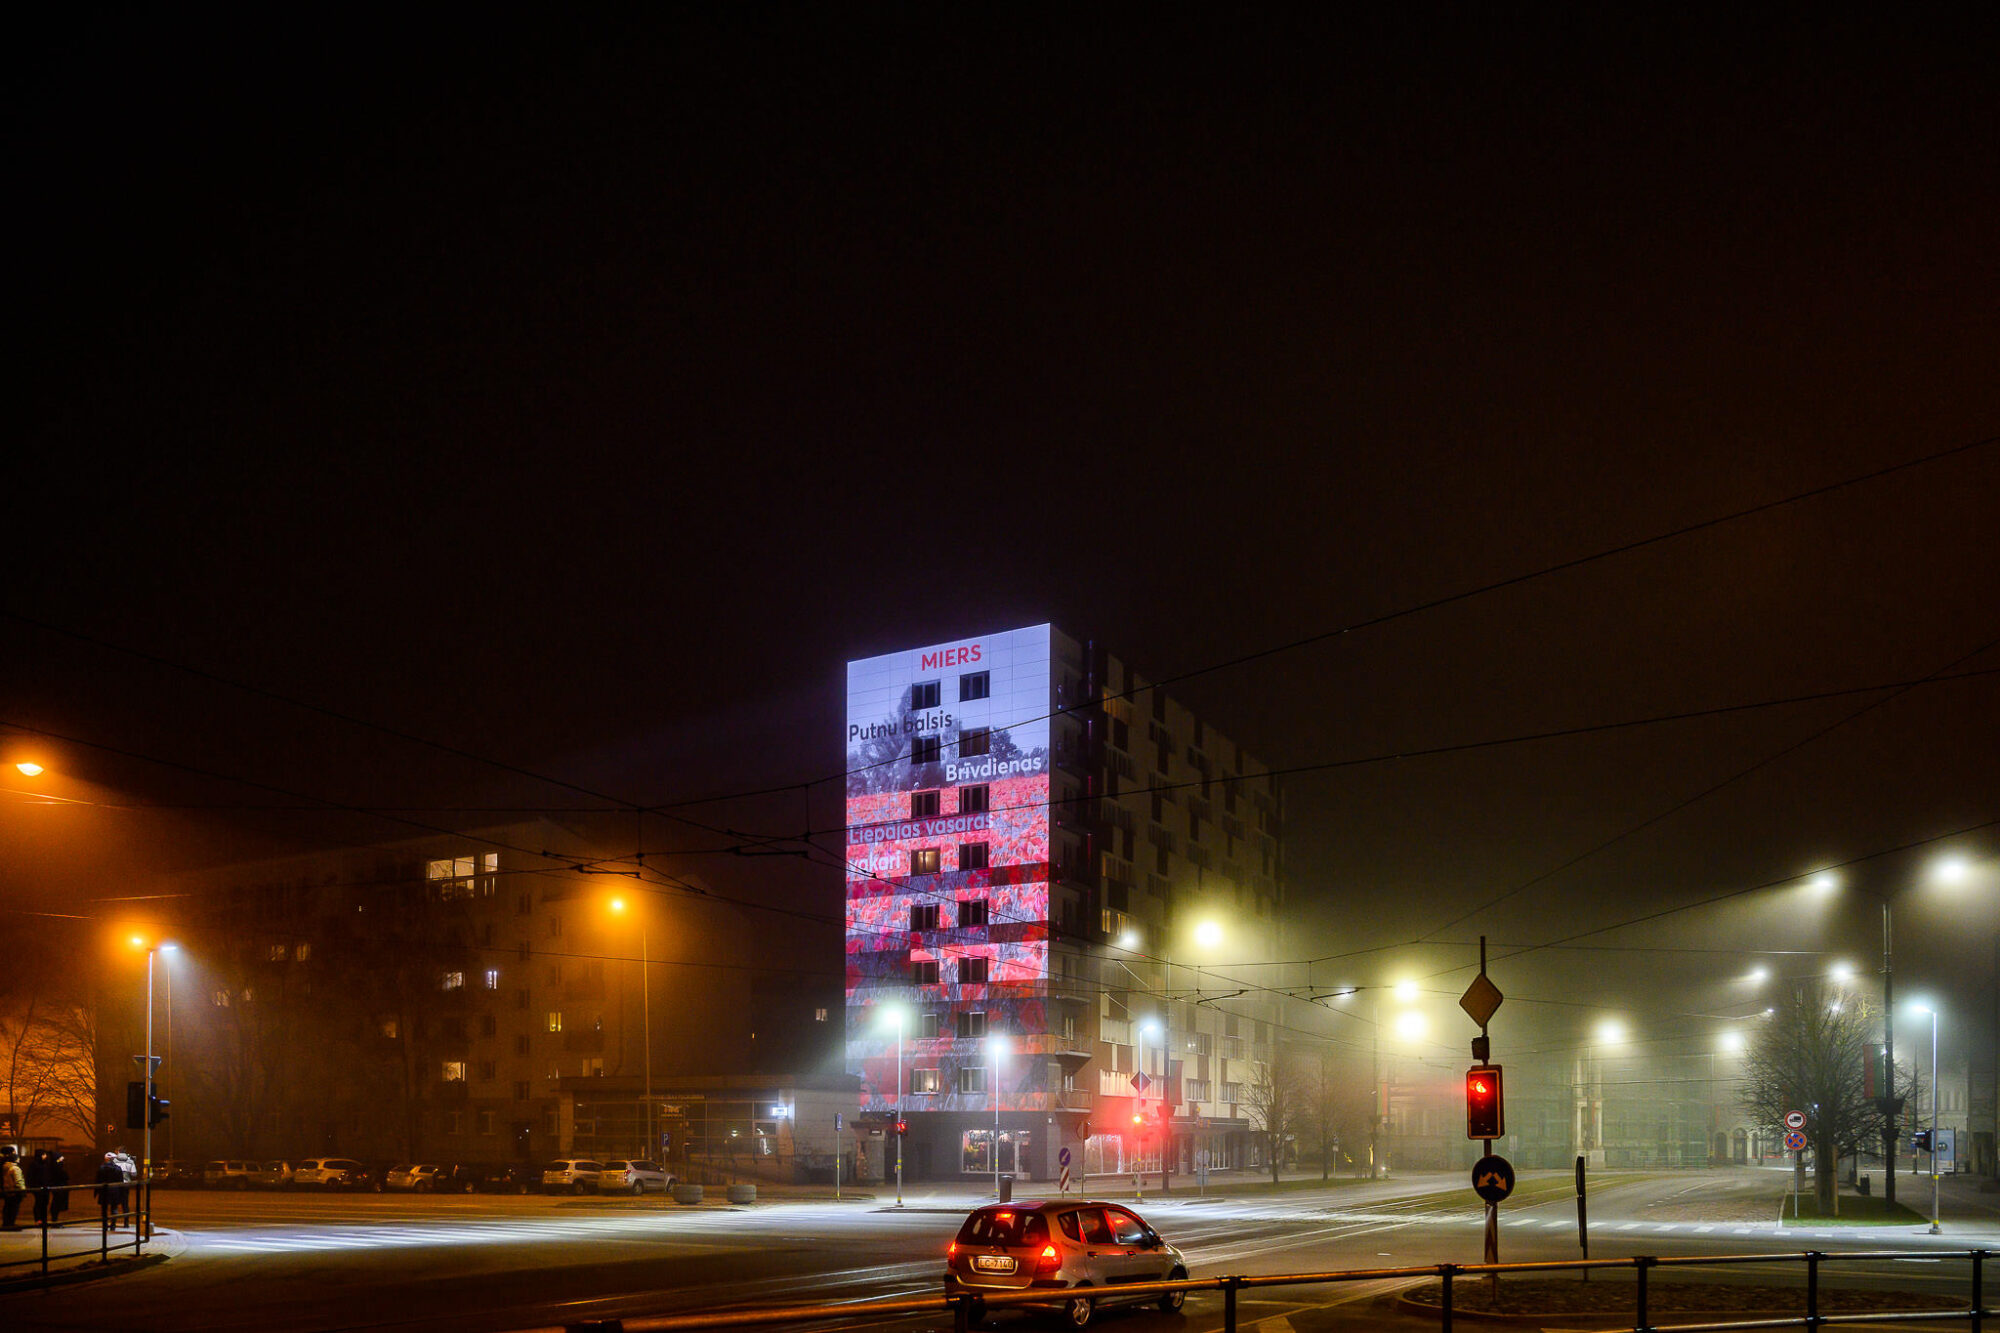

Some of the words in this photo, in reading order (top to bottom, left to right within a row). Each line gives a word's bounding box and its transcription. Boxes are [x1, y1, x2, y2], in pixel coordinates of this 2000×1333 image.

[921, 644, 982, 671] MIERS
[849, 722, 897, 742] Putnu
[903, 710, 953, 733] balsis
[945, 757, 1042, 782] Brīvdienas
[925, 814, 994, 836] vasaras
[848, 850, 901, 873] vakari
